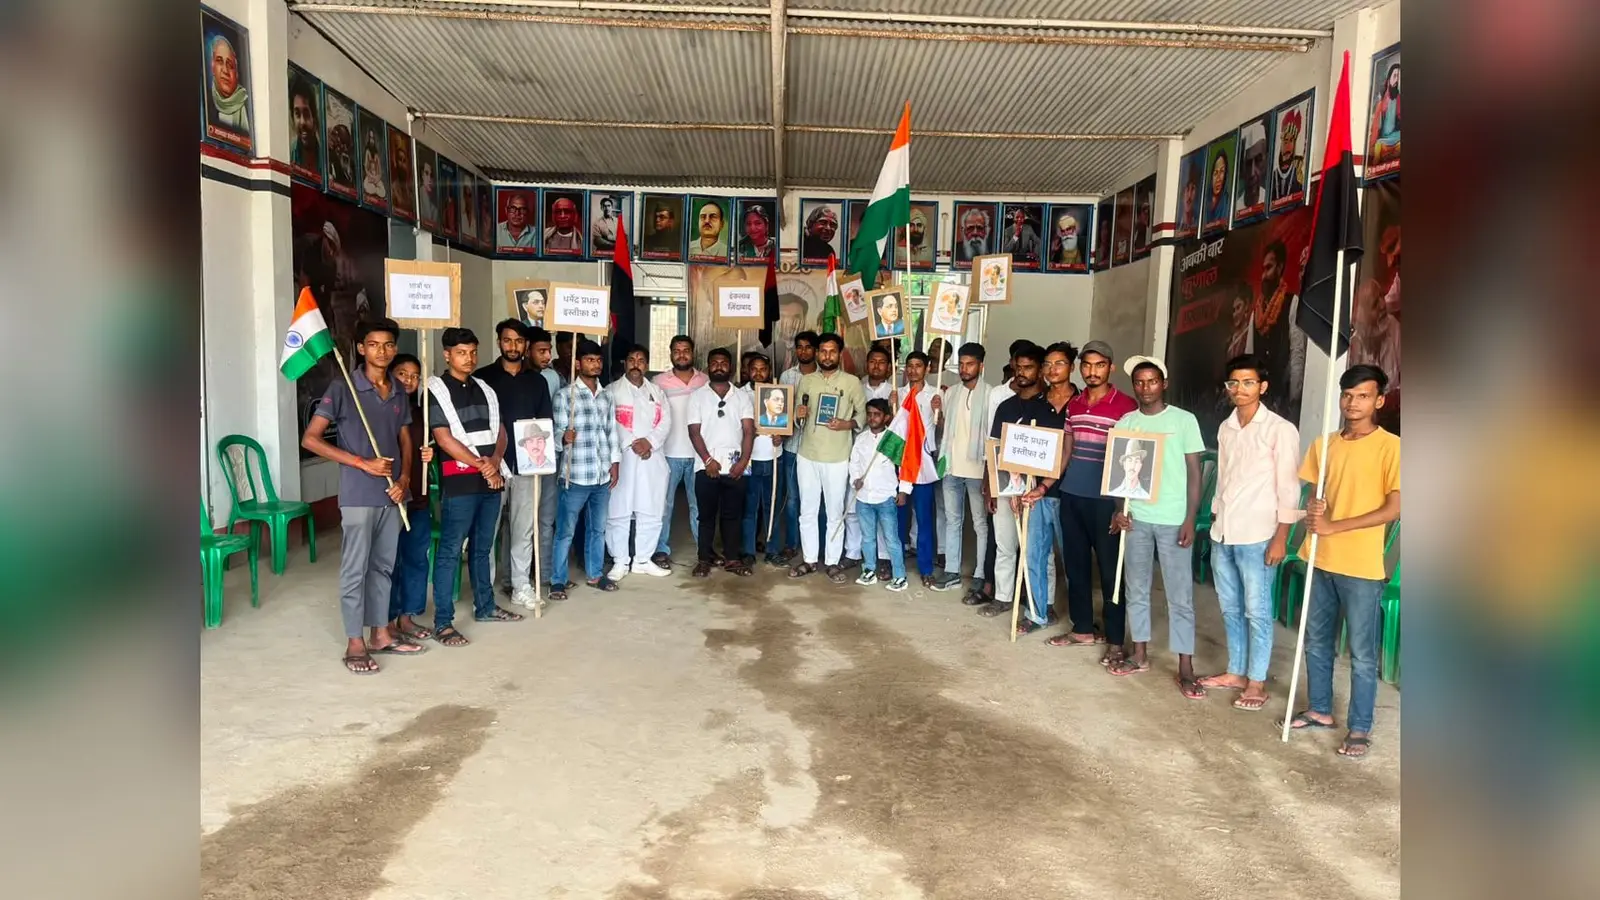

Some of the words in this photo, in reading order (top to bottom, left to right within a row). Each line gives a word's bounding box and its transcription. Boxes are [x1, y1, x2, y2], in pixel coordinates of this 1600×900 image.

[1180, 243, 1206, 272] अबकी
[1207, 238, 1225, 257] बार
[581, 296, 600, 305] प्रधान
[591, 309, 599, 318] दो
[1031, 437, 1049, 447] प्रधान
[1038, 451, 1047, 460] दो
